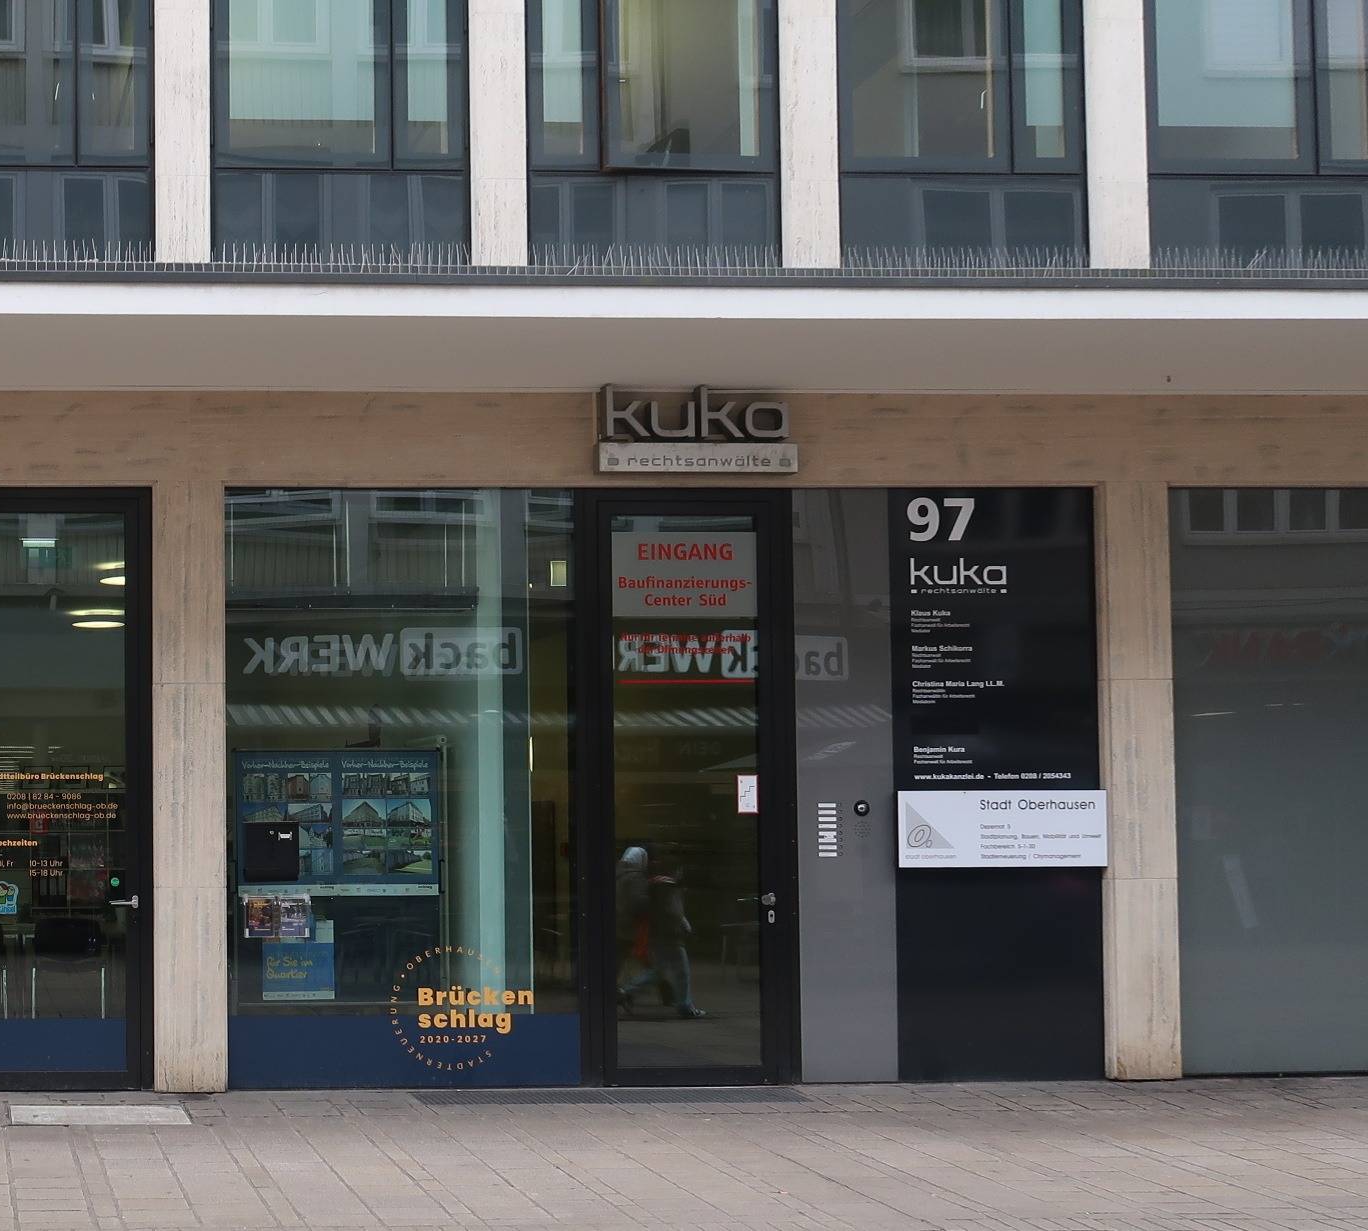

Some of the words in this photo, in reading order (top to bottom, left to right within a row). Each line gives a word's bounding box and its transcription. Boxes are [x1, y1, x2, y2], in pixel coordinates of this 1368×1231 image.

[604, 384, 790, 438] kuka
[627, 455, 772, 467] rechtsanwälte
[906, 496, 975, 542] 97
[637, 543, 734, 561] EINGANG
[910, 557, 1007, 585] kuka
[618, 576, 752, 591] Baufinanzierungs-
[644, 594, 692, 606] Center
[699, 593, 727, 606] Süd
[966, 680, 984, 688] Lang
[913, 746, 947, 754] Benjamin
[40, 772, 104, 782] Brückenschlag
[6, 803, 119, 812] info@brueckenschlag-ob.de
[979, 799, 1012, 810] Stadt
[1017, 798, 1096, 810] Oberhausen
[6, 812, 117, 821] www.brueckenschlag-ob.de
[418, 985, 534, 1006] Brücken
[418, 1009, 512, 1034] schlag
[419, 1035, 487, 1043] 2020-2027
